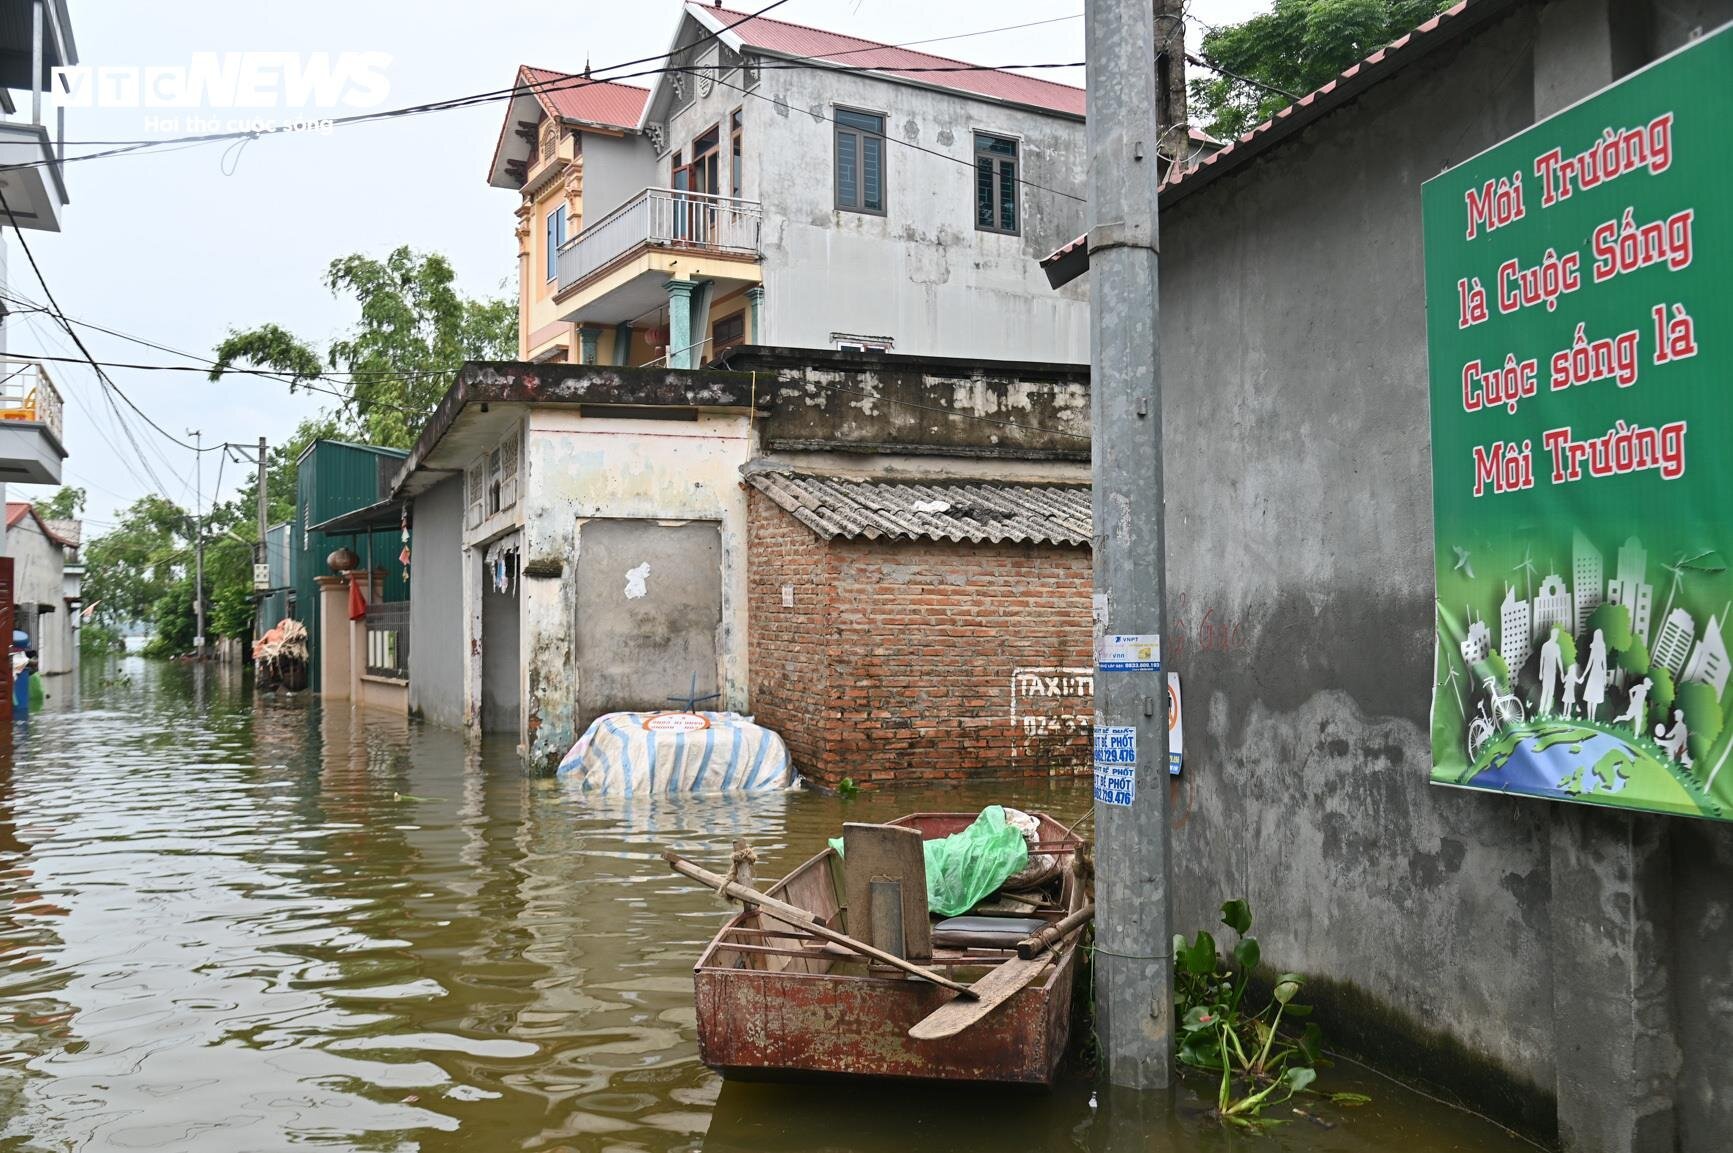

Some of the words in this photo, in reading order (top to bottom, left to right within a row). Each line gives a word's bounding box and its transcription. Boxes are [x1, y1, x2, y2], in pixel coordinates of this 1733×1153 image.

[1464, 173, 1525, 240] Môi
[1535, 112, 1673, 207] Trường
[1458, 272, 1487, 329] là
[1498, 249, 1580, 312] Cuộc
[1593, 207, 1694, 283] Sống
[1462, 354, 1537, 414] Cuộc
[1551, 322, 1638, 392] sống
[1652, 304, 1697, 365] là
[1473, 440, 1534, 496] Môi
[1543, 420, 1686, 484] Trường
[1111, 734, 1134, 748] PHỐT
[1112, 767, 1134, 776] PHỐT
[1108, 777, 1131, 790] PHỐT
